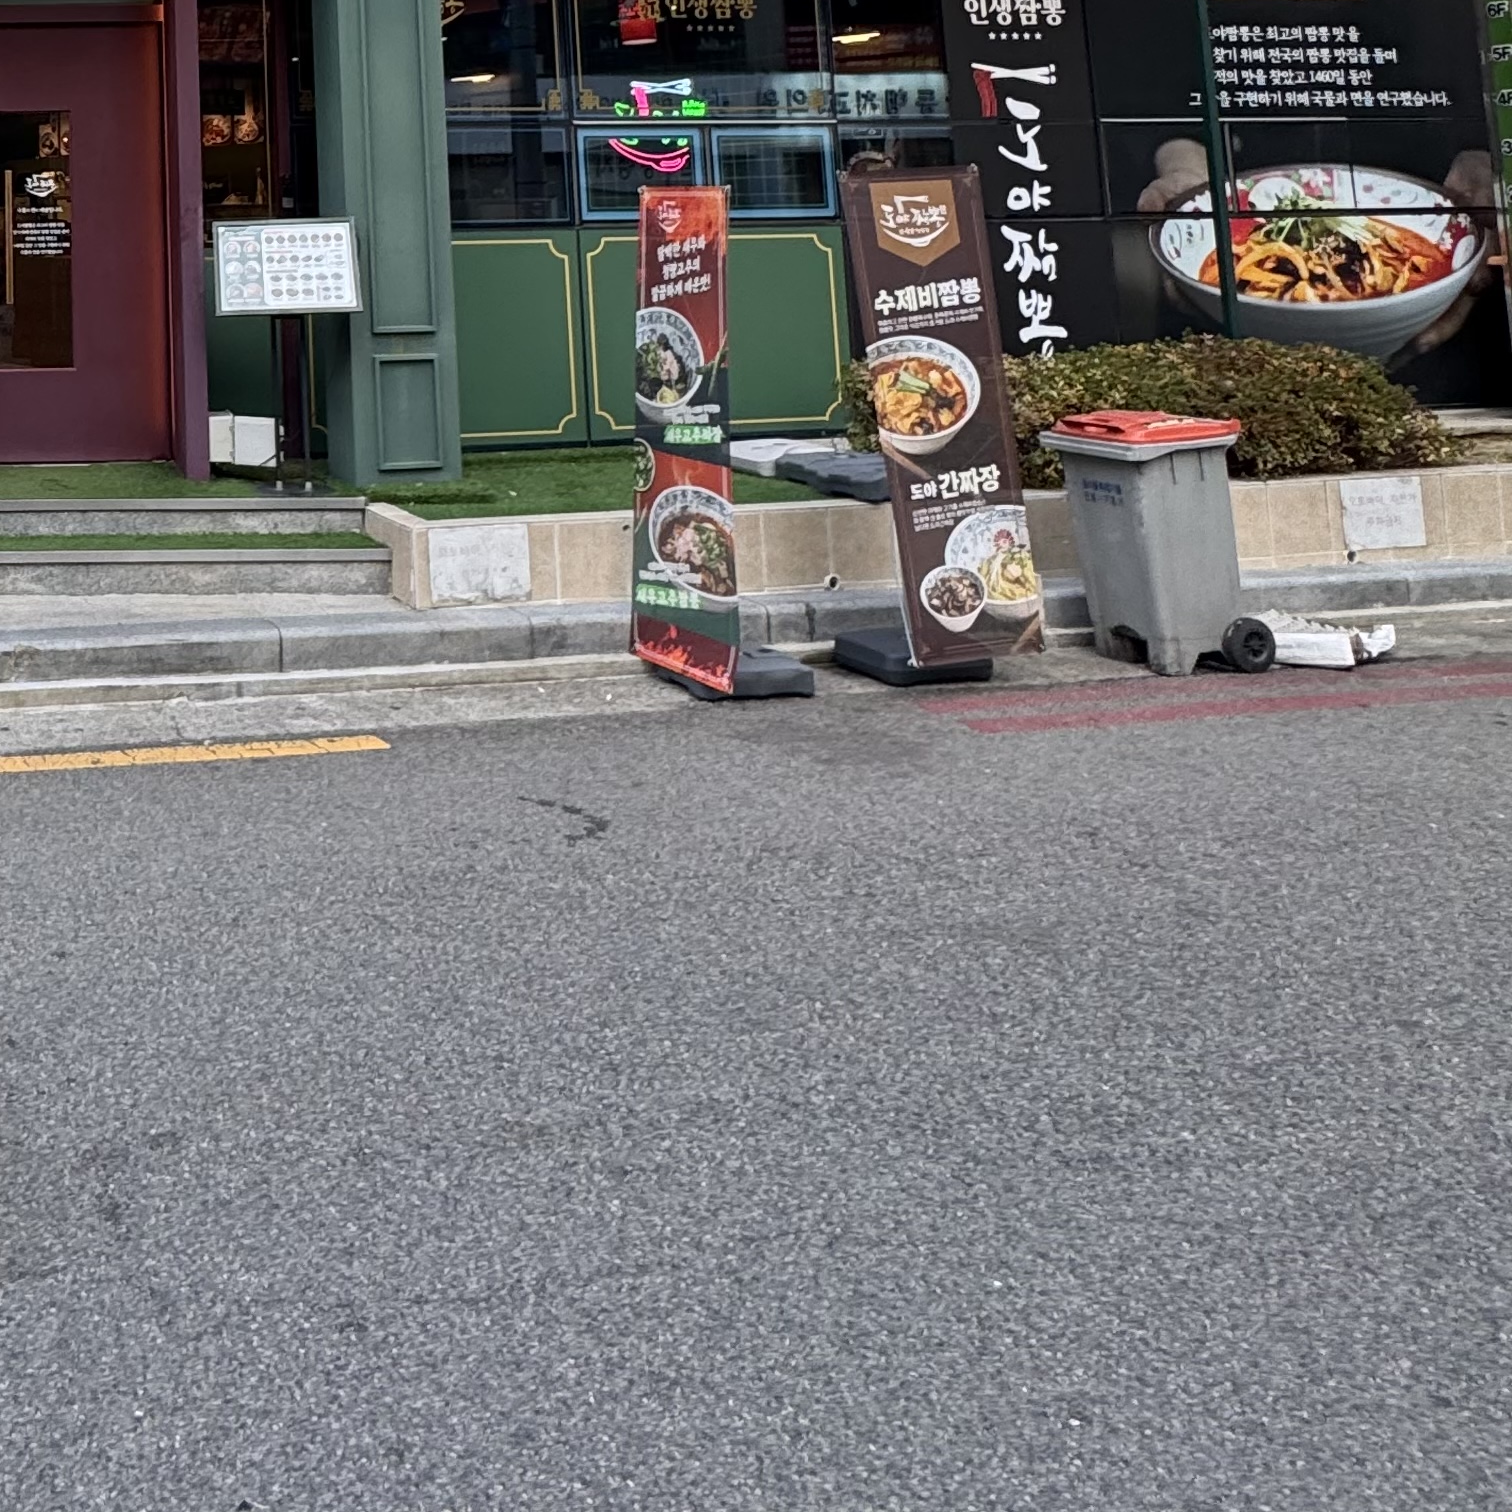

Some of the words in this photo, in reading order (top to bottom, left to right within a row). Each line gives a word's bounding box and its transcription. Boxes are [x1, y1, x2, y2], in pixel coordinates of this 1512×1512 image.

[1487, 1, 1508, 17] 6F
[1209, 26, 1264, 43] 야짬뽕은
[1265, 26, 1303, 43] 최고의
[1304, 26, 1331, 43] 짬뽕
[1212, 47, 1238, 64] 찾기
[1240, 48, 1266, 64] 위해
[1268, 48, 1305, 64] 전국의
[1306, 48, 1332, 64] 짬뽕
[1333, 48, 1370, 64] 맛집을
[1241, 69, 1268, 85] 맛을
[1347, 69, 1373, 85] 동안
[1234, 91, 1282, 107] 구현하기
[1284, 91, 1311, 107] 위해
[1312, 91, 1349, 107] 국물과
[1350, 91, 1375, 107] 면을
[874, 276, 982, 316] 수제비짬뽕
[909, 480, 937, 501] 도야
[938, 464, 1001, 500] 간짜장
